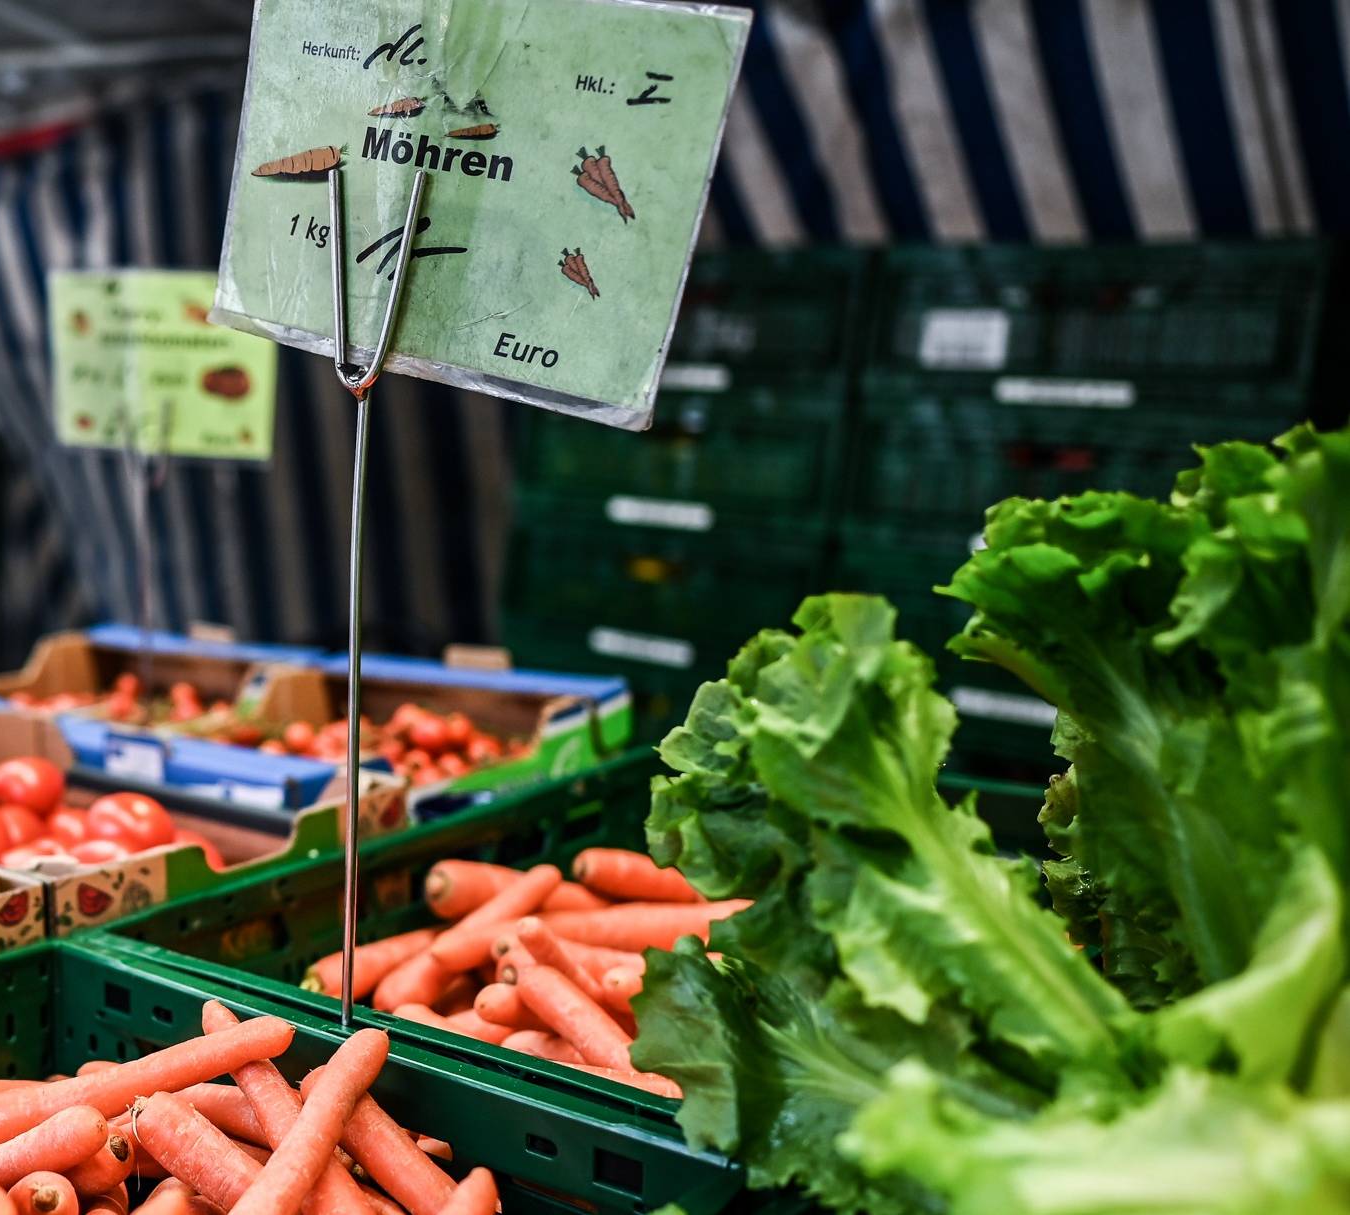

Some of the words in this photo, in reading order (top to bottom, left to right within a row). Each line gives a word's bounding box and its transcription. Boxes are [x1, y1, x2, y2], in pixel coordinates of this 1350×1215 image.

[302, 40, 361, 61] Herkunft:
[575, 75, 615, 95] Hkl.:
[361, 126, 514, 182] Möhren
[290, 213, 300, 236] 1
[305, 216, 331, 249] kg
[493, 332, 559, 368] Euro
